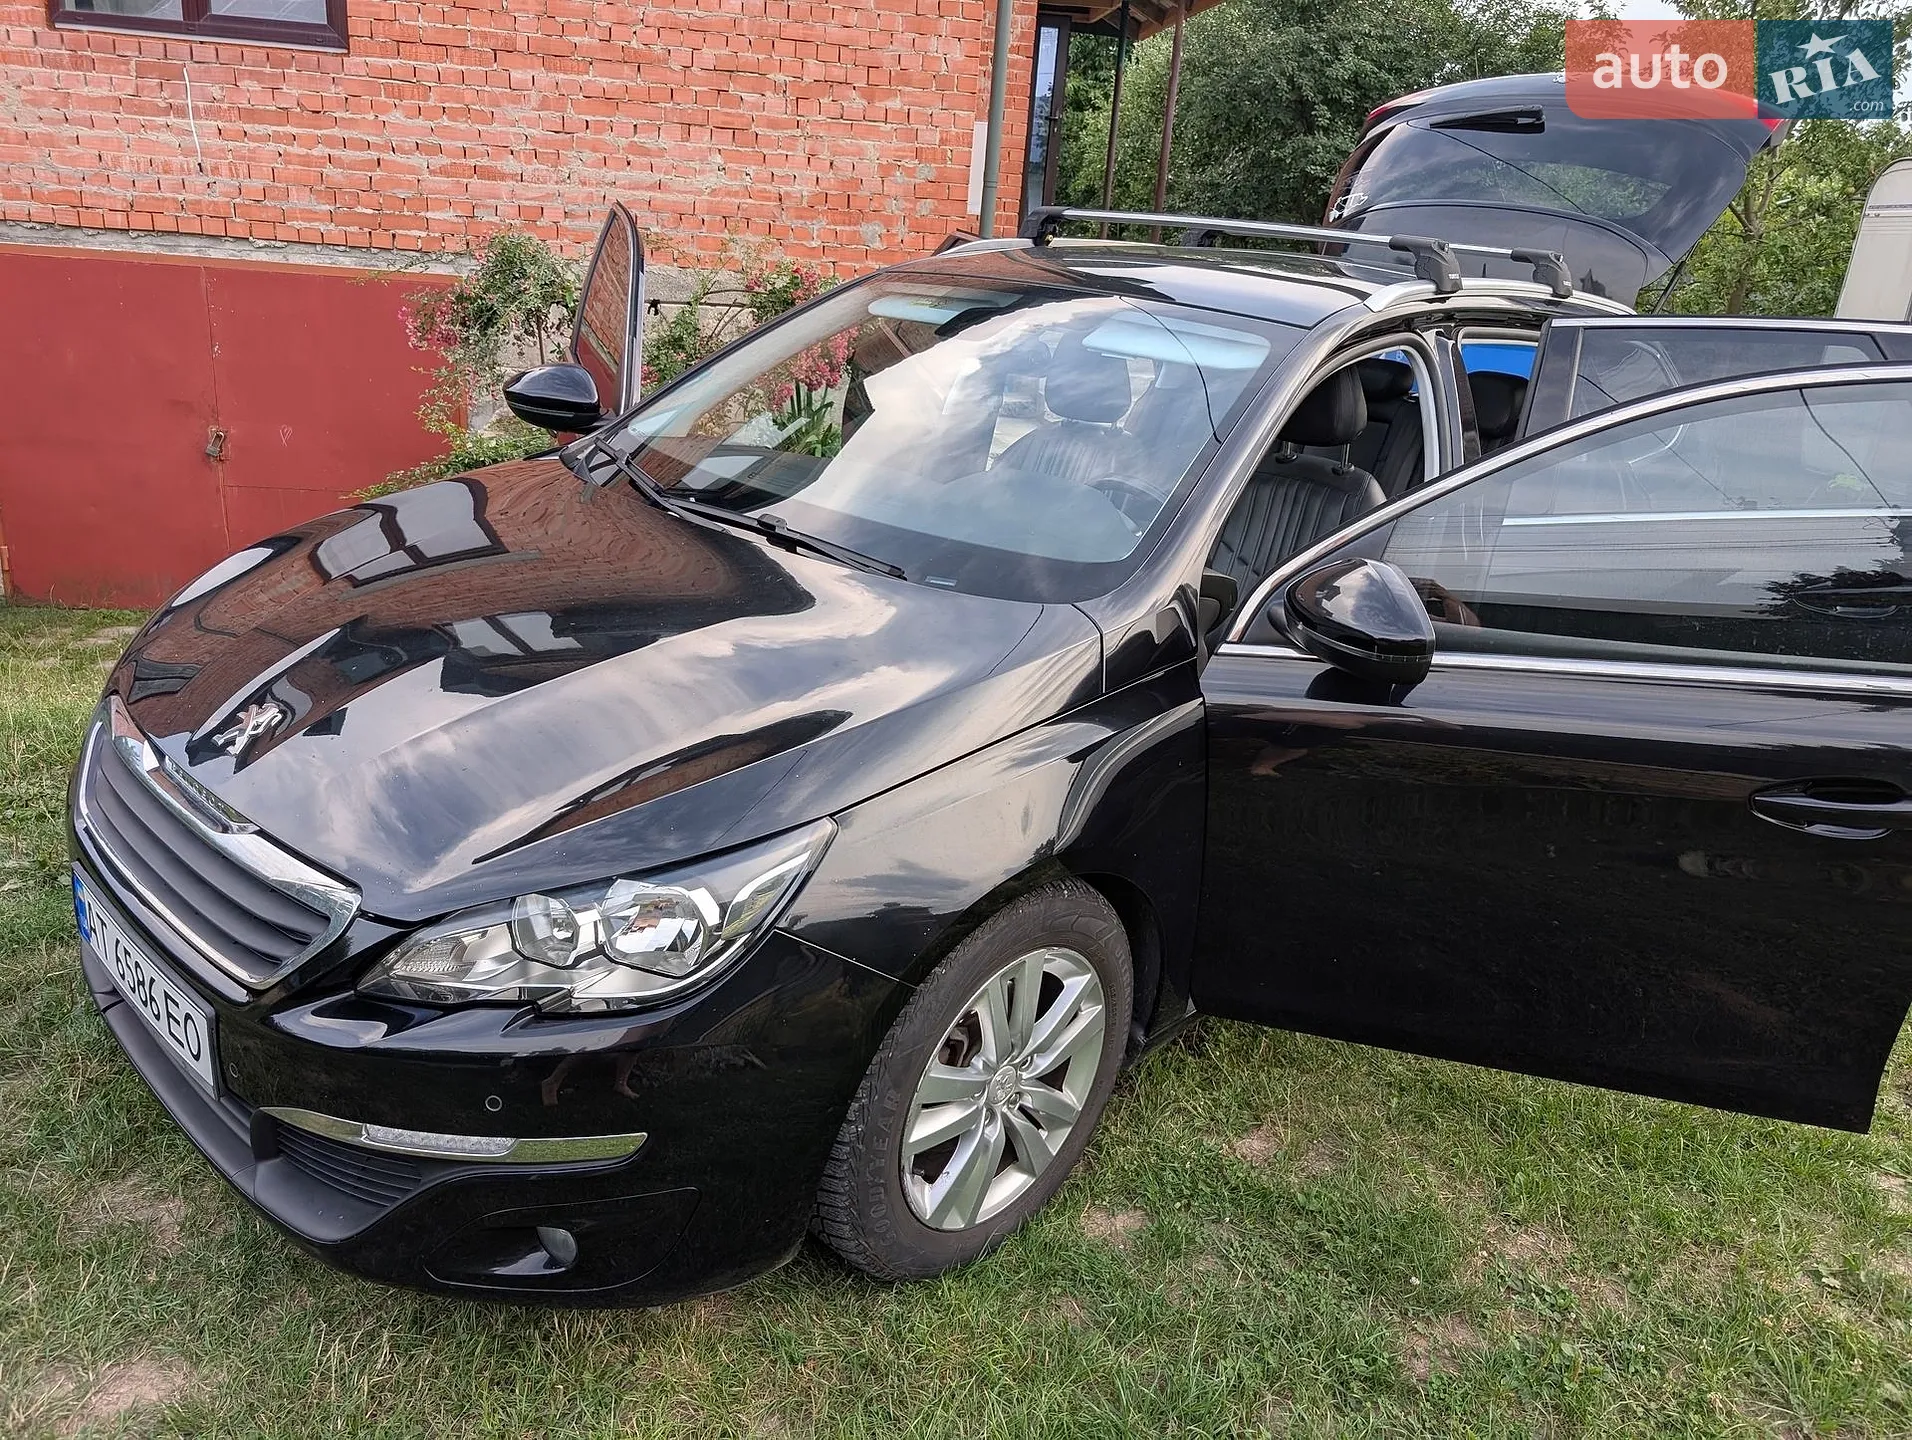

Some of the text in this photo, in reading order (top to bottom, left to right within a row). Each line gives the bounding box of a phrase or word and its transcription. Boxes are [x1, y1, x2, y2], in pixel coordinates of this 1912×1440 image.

[87, 900, 201, 1062] AT 6586 EO
[866, 1089, 901, 1247] GOODYEAR
